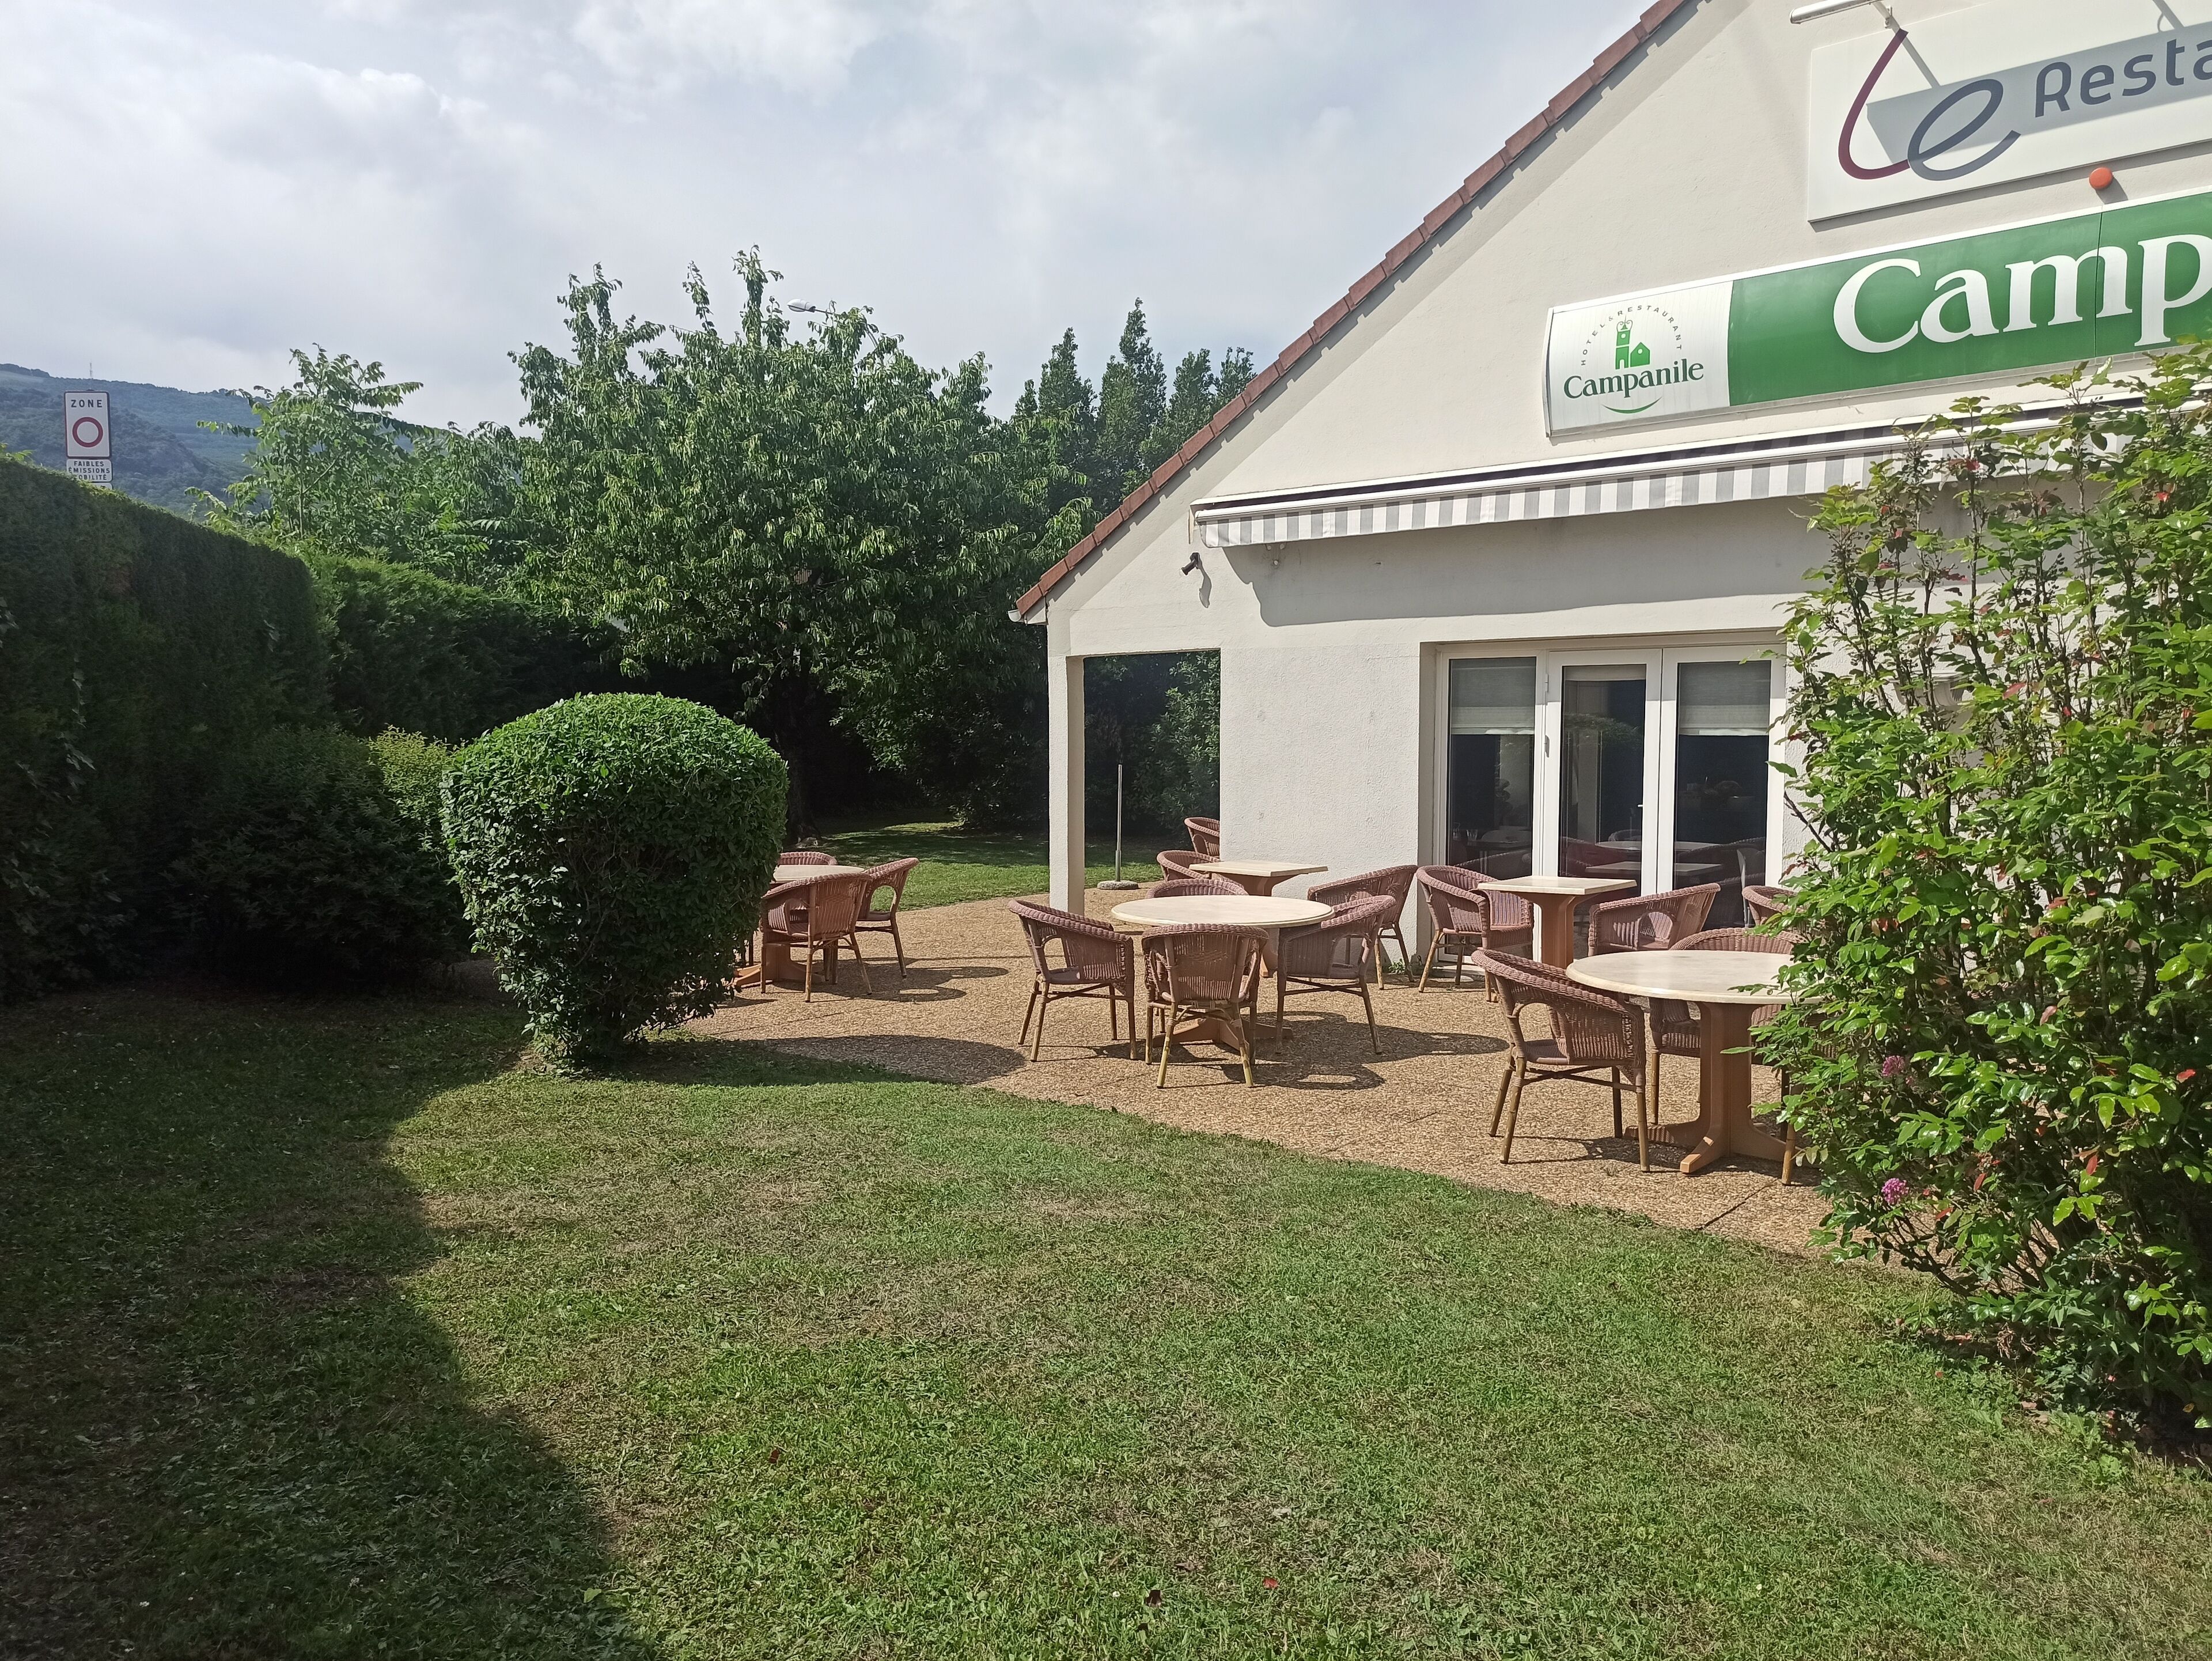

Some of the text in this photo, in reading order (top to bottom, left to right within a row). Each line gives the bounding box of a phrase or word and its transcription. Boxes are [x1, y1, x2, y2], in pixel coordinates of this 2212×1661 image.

[1833, 234, 2212, 353] Camp
[1618, 305, 1681, 350] RESTAURANT
[1564, 358, 1704, 398] Campanile
[71, 399, 103, 408] ZONE
